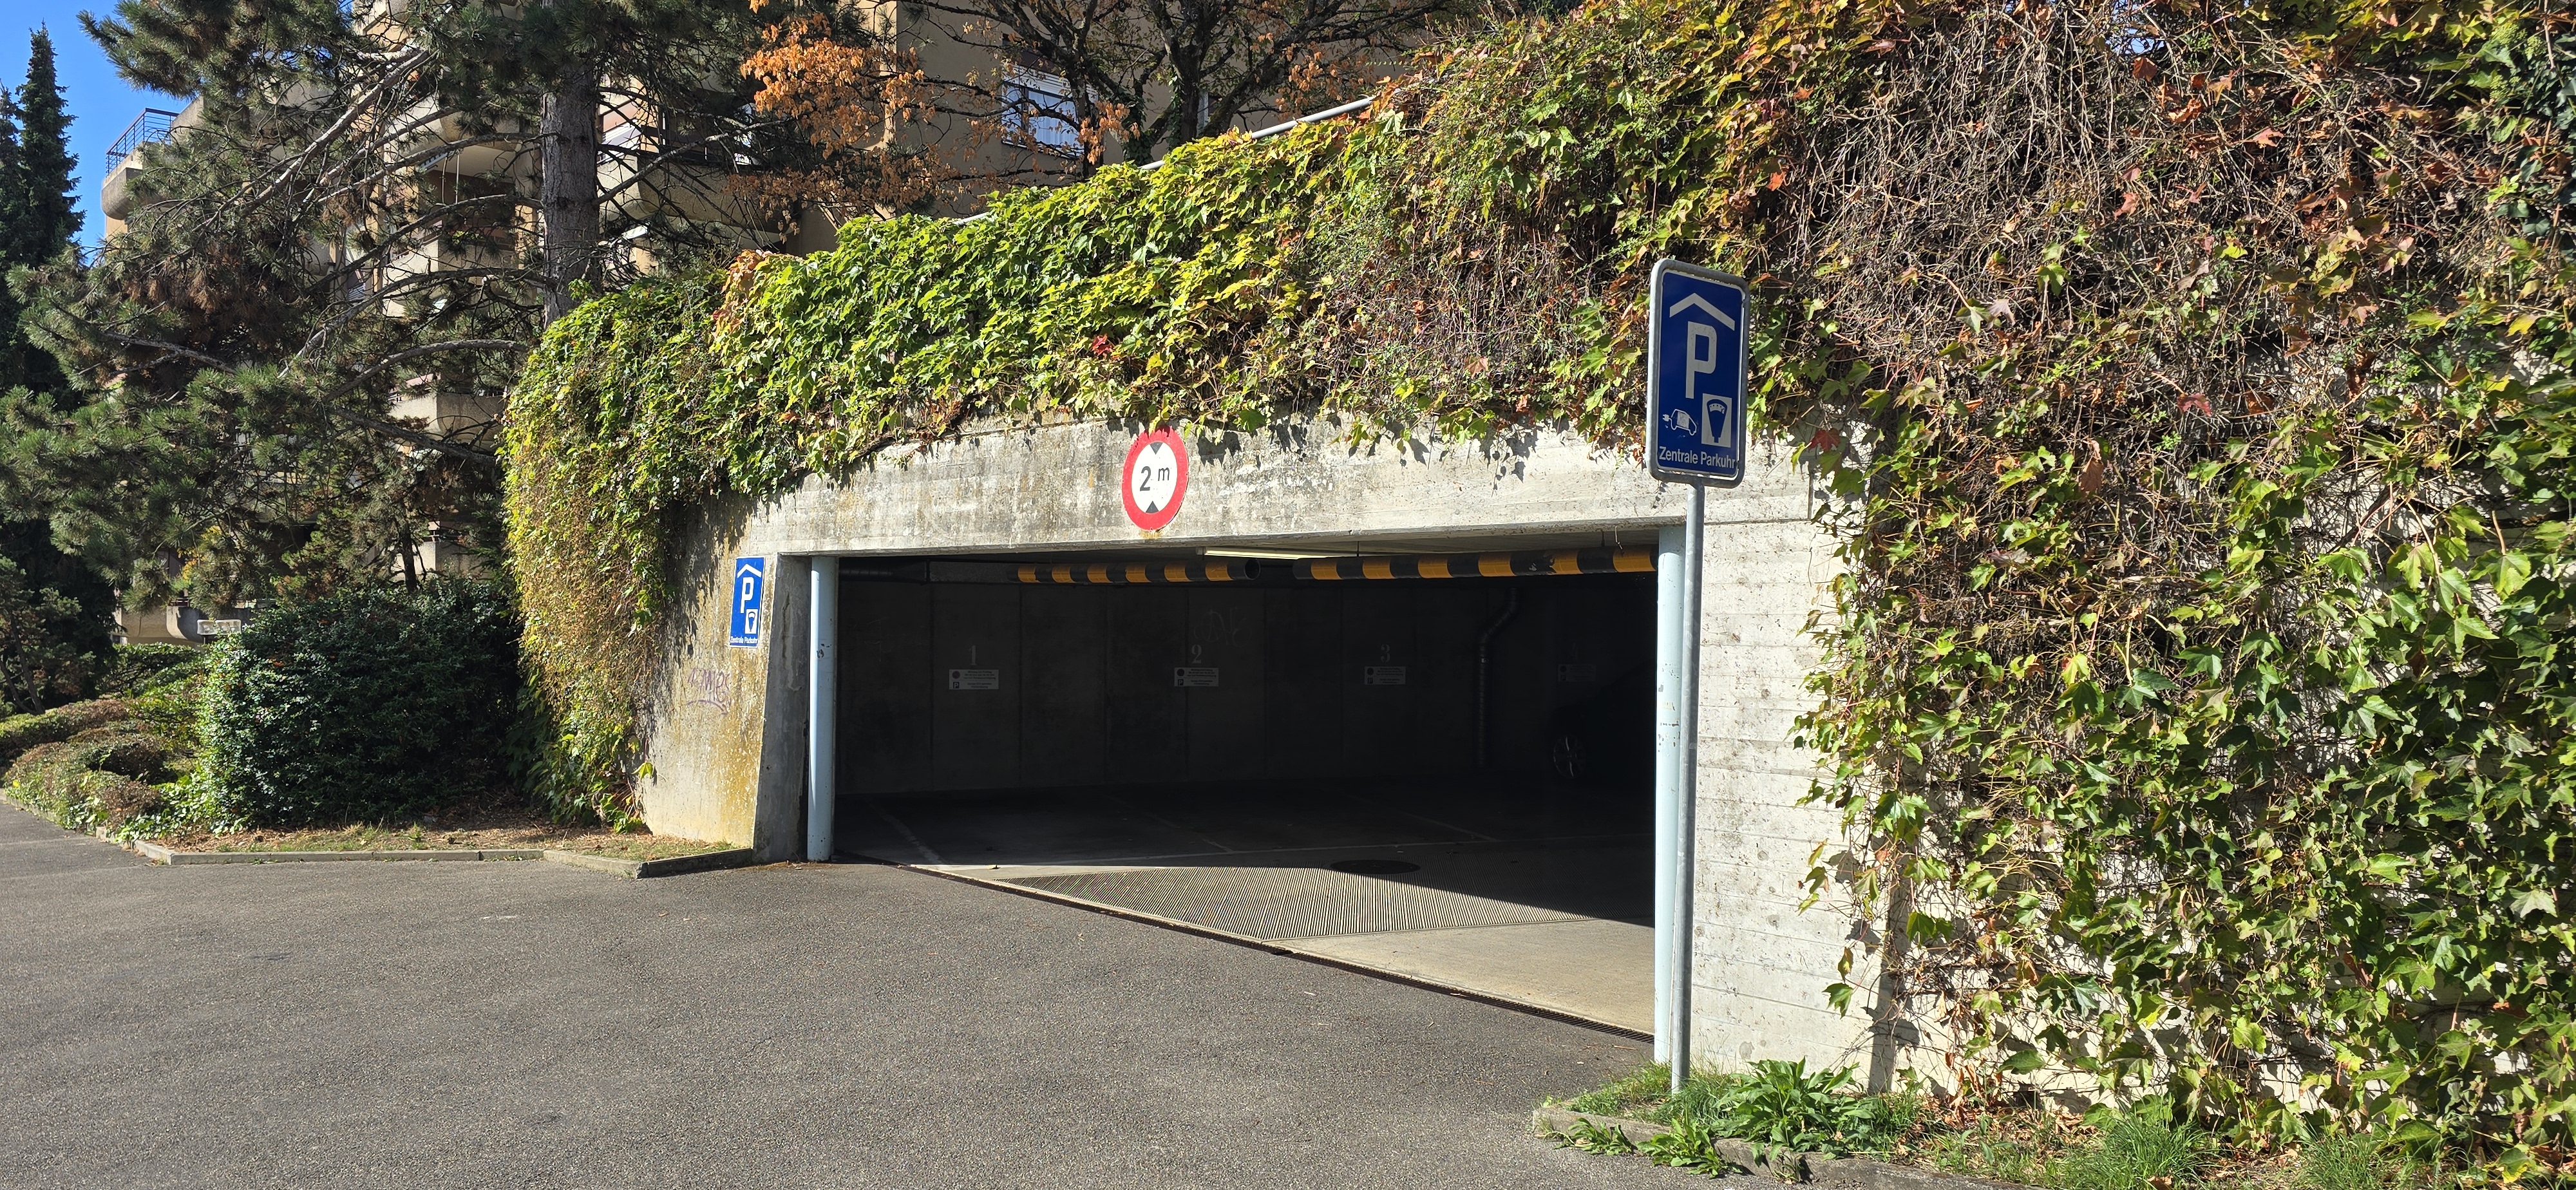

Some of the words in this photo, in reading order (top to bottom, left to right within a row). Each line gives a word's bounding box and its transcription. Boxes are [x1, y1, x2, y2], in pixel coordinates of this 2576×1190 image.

[1685, 321, 1718, 399] P
[1659, 446, 1698, 465] Zentrale
[1701, 451, 1736, 469] Parkuhr
[1139, 466, 1151, 492] 2
[1158, 467, 1170, 482] m
[740, 577, 754, 614] P
[969, 645, 977, 665] 1
[1191, 644, 1202, 664] 2
[1380, 644, 1390, 663] 3
